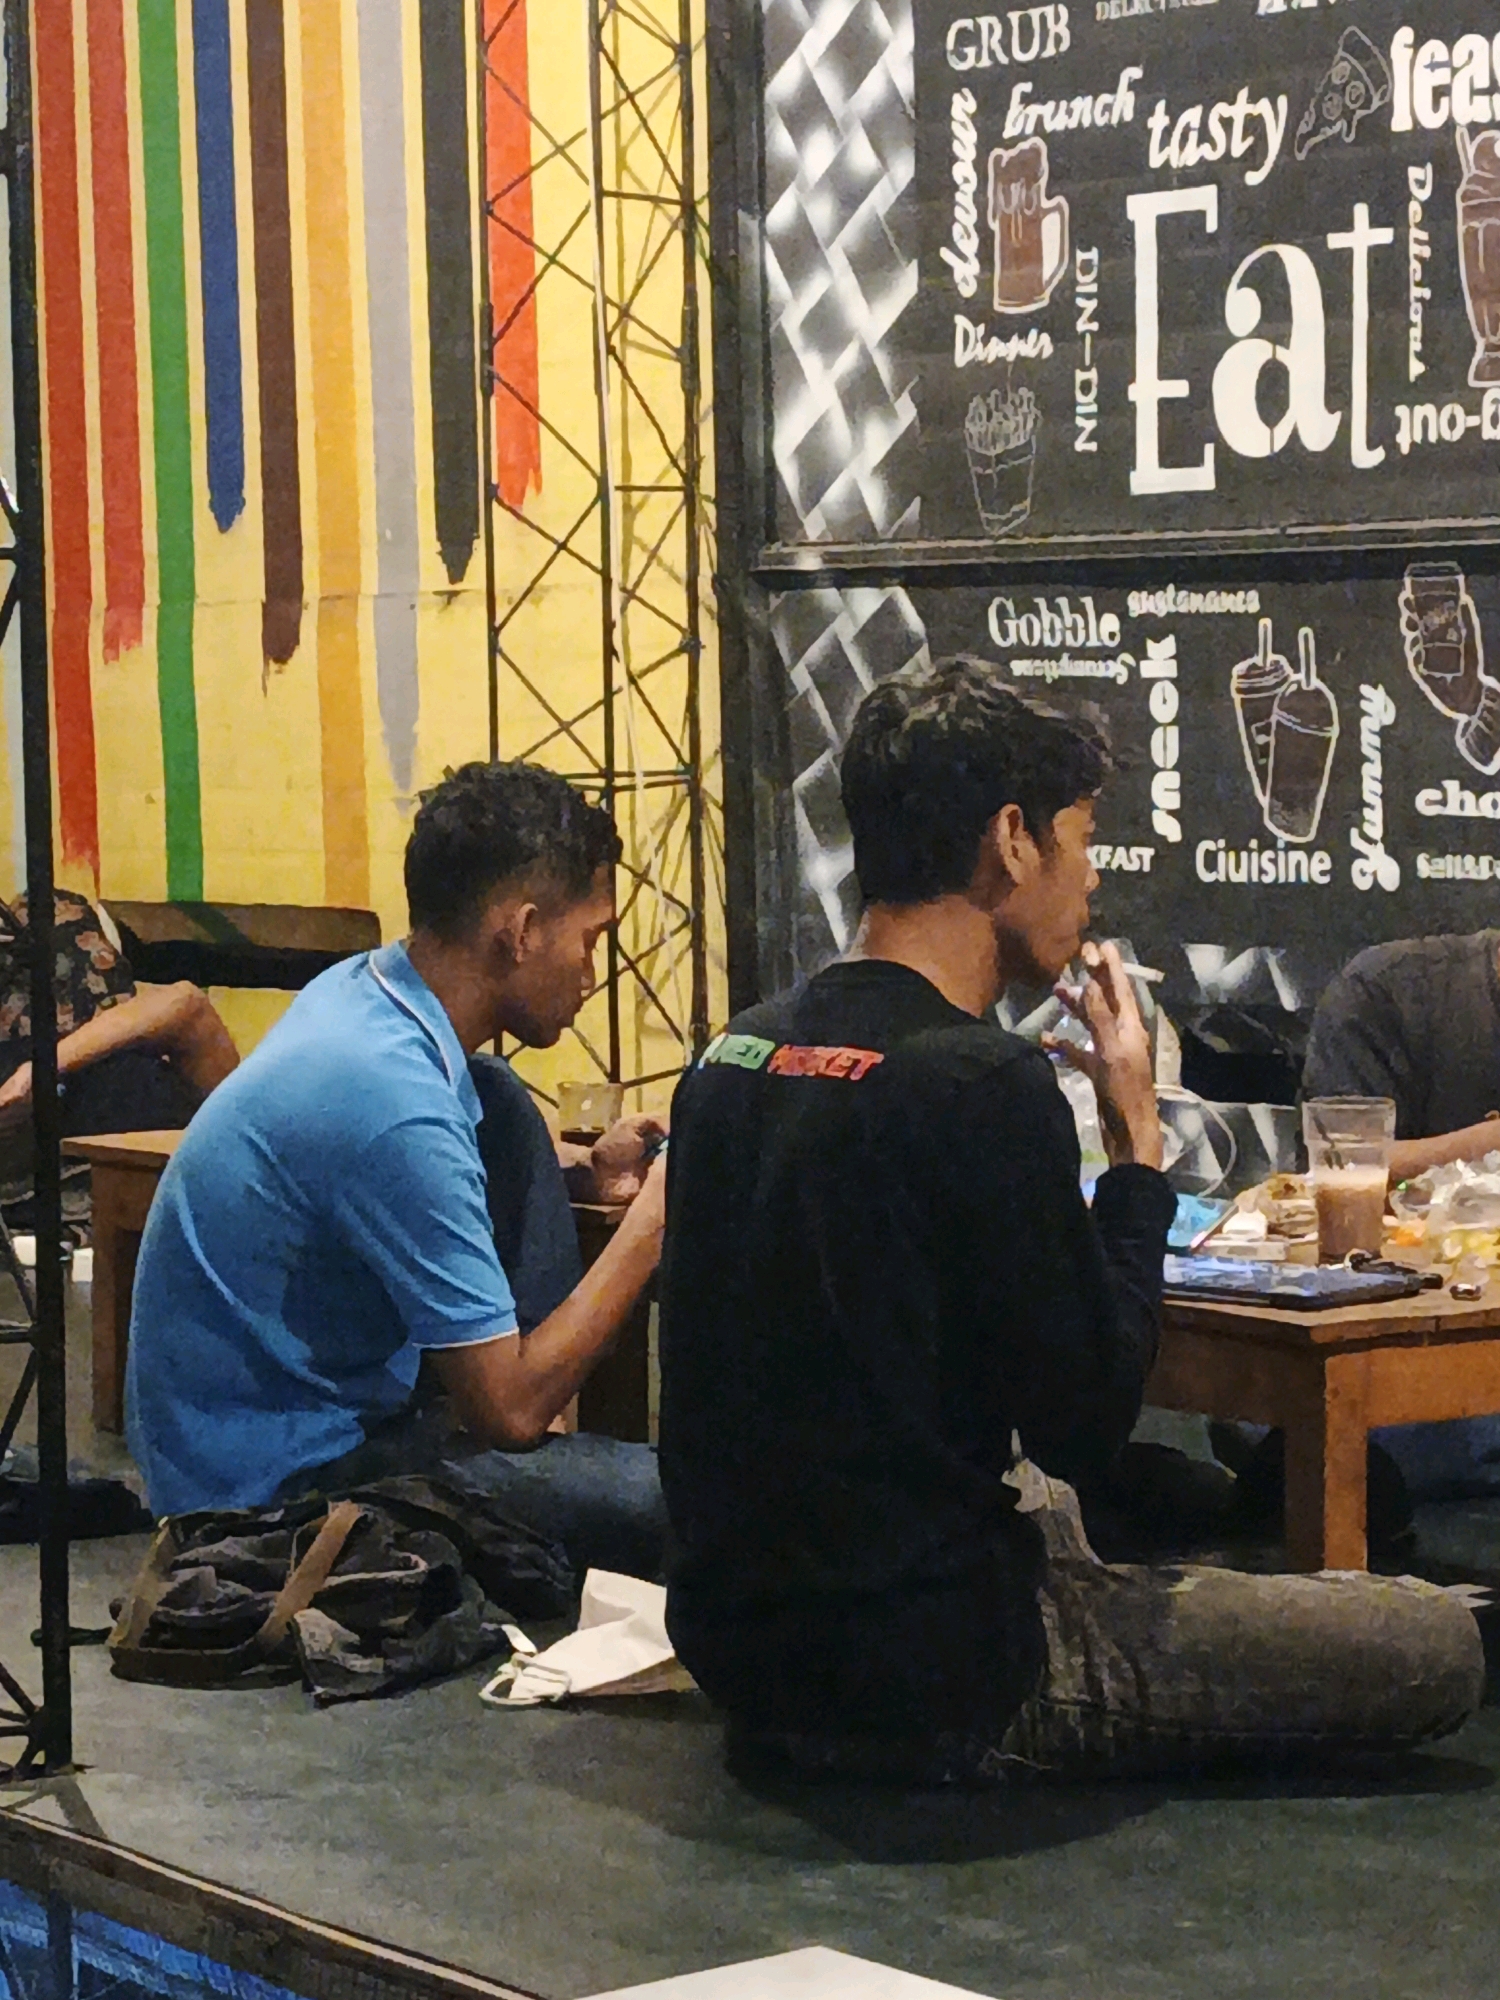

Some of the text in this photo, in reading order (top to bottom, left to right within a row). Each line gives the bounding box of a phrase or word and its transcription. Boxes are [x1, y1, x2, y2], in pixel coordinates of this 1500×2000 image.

[946, 3, 1071, 71] GRUB
[1390, 26, 1500, 132] fea
[1002, 65, 1144, 139] brunch
[1147, 86, 1288, 186] tasty
[939, 87, 980, 298] devour
[1408, 162, 1433, 382] Delicious
[954, 314, 1054, 368] Dinner
[1126, 184, 1396, 495] Eat
[988, 596, 1121, 648] Gobble
[1140, 634, 1182, 842] snack
[1350, 684, 1400, 891] Yummy
[1083, 843, 1155, 867] KFAST
[1196, 838, 1332, 885] Ciuisine
